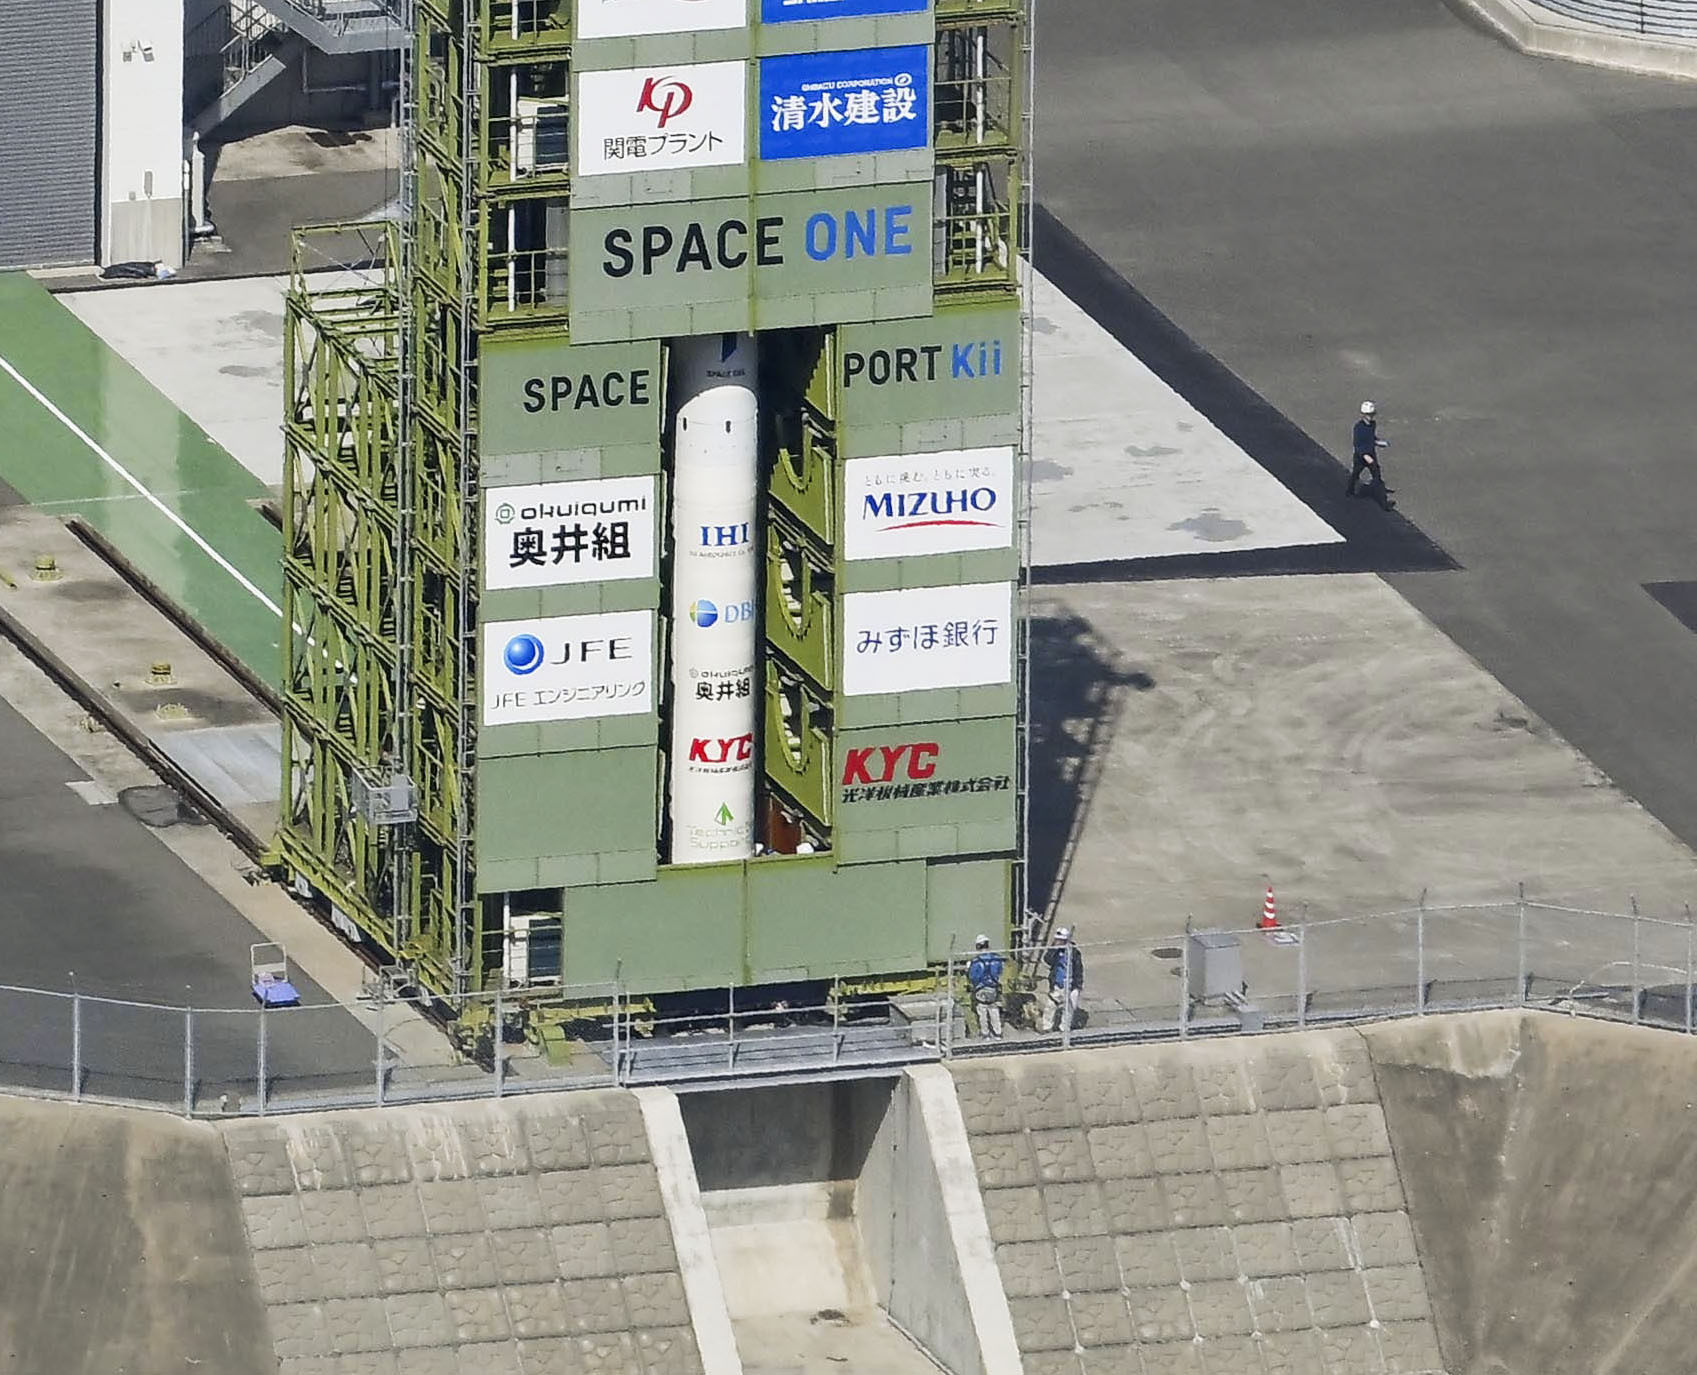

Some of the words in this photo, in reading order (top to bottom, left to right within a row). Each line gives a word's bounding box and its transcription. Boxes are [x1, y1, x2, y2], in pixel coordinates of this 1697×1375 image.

[771, 86, 917, 132] 清水建設
[604, 131, 723, 160] 関電プラント
[603, 216, 784, 277] SPACE
[805, 205, 913, 261] ONE
[523, 370, 649, 413] SPACE
[843, 345, 942, 388] PORT
[952, 340, 1001, 378] Kii
[862, 487, 997, 520] MIZUHO
[509, 522, 631, 568] 奥井組
[700, 522, 749, 546] IHI
[549, 637, 632, 665] JFE
[856, 619, 999, 654] みずほ銀行
[491, 692, 527, 710] JFE
[533, 681, 646, 706] エンジニアリング
[689, 732, 753, 763] KYC
[842, 742, 939, 786] KYC
